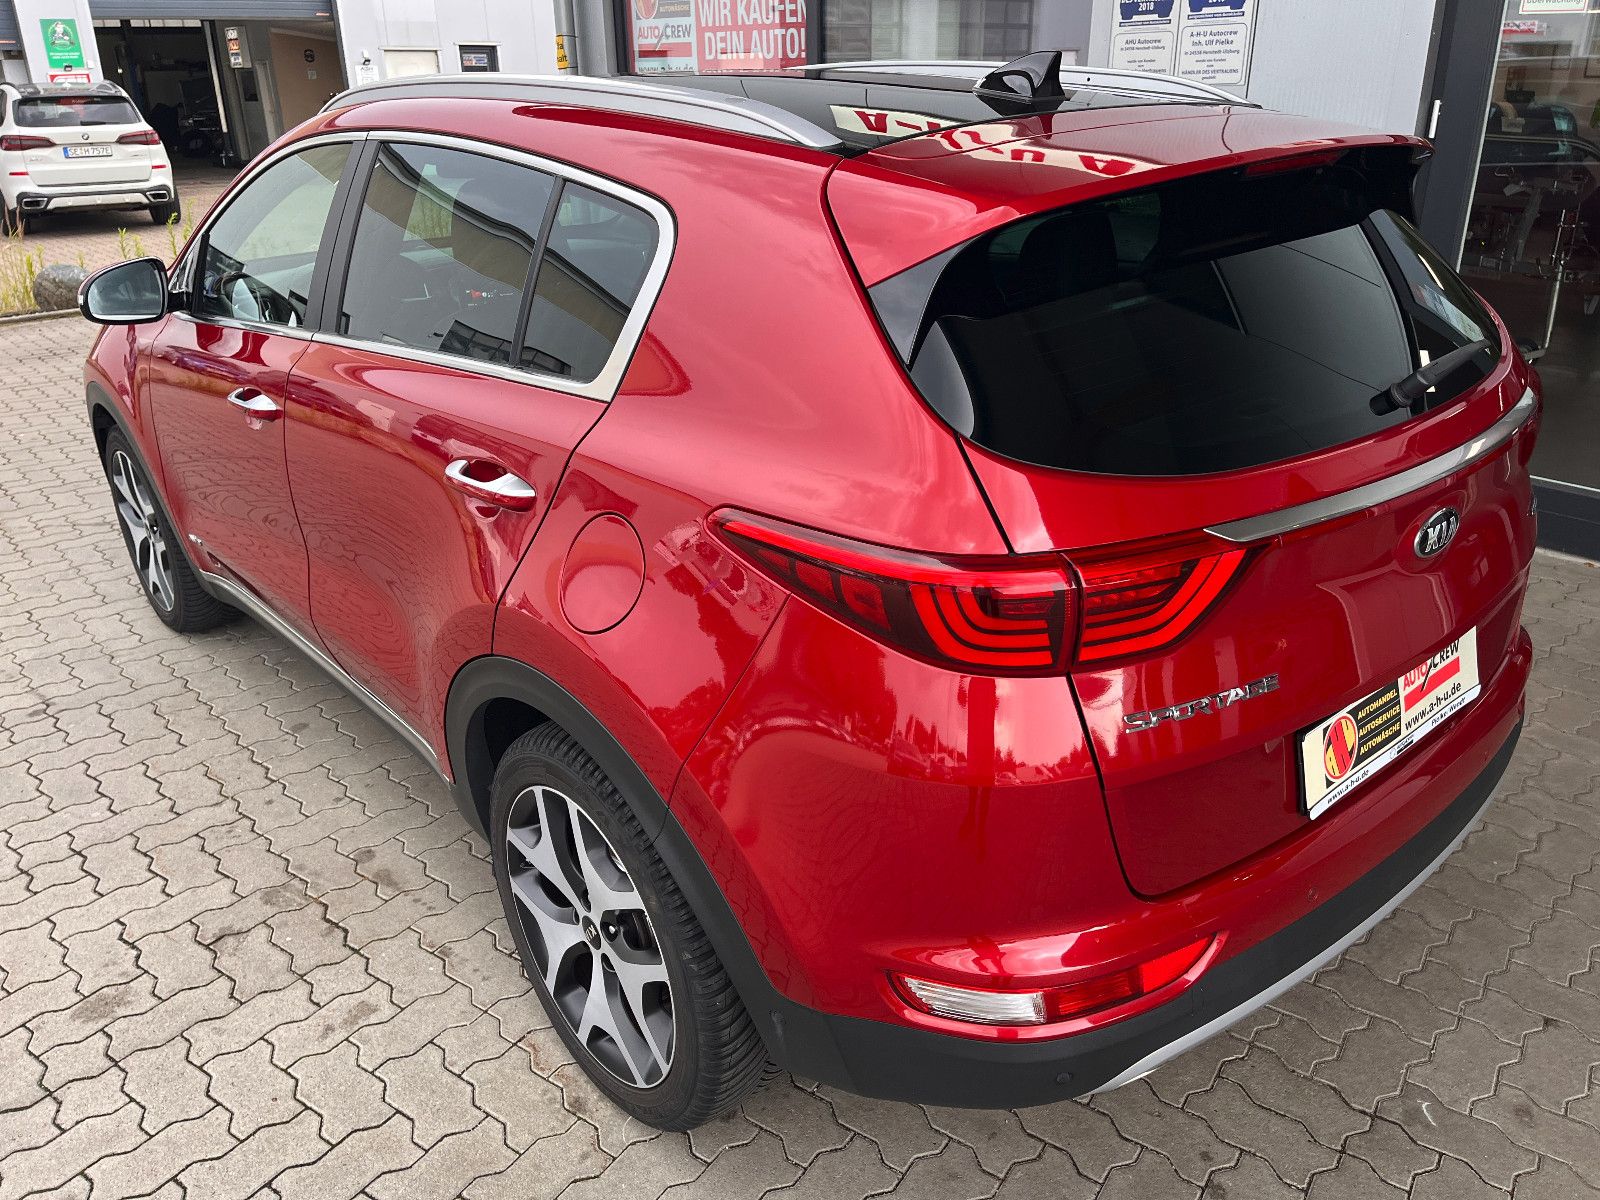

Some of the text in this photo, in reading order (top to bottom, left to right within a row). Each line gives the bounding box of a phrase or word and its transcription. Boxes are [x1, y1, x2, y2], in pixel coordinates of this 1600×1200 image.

[698, 0, 732, 27] WIR
[1138, 2, 1154, 11] 2018
[704, 28, 806, 60] DEIN AUTO!
[1425, 516, 1457, 553] KIA
[1123, 673, 1280, 734] SPORTAGE
[1358, 688, 1398, 720] AUTOHANDEL
[1404, 682, 1461, 731] www.a-h-u.de
[1359, 704, 1400, 738] AUTOSERVICE
